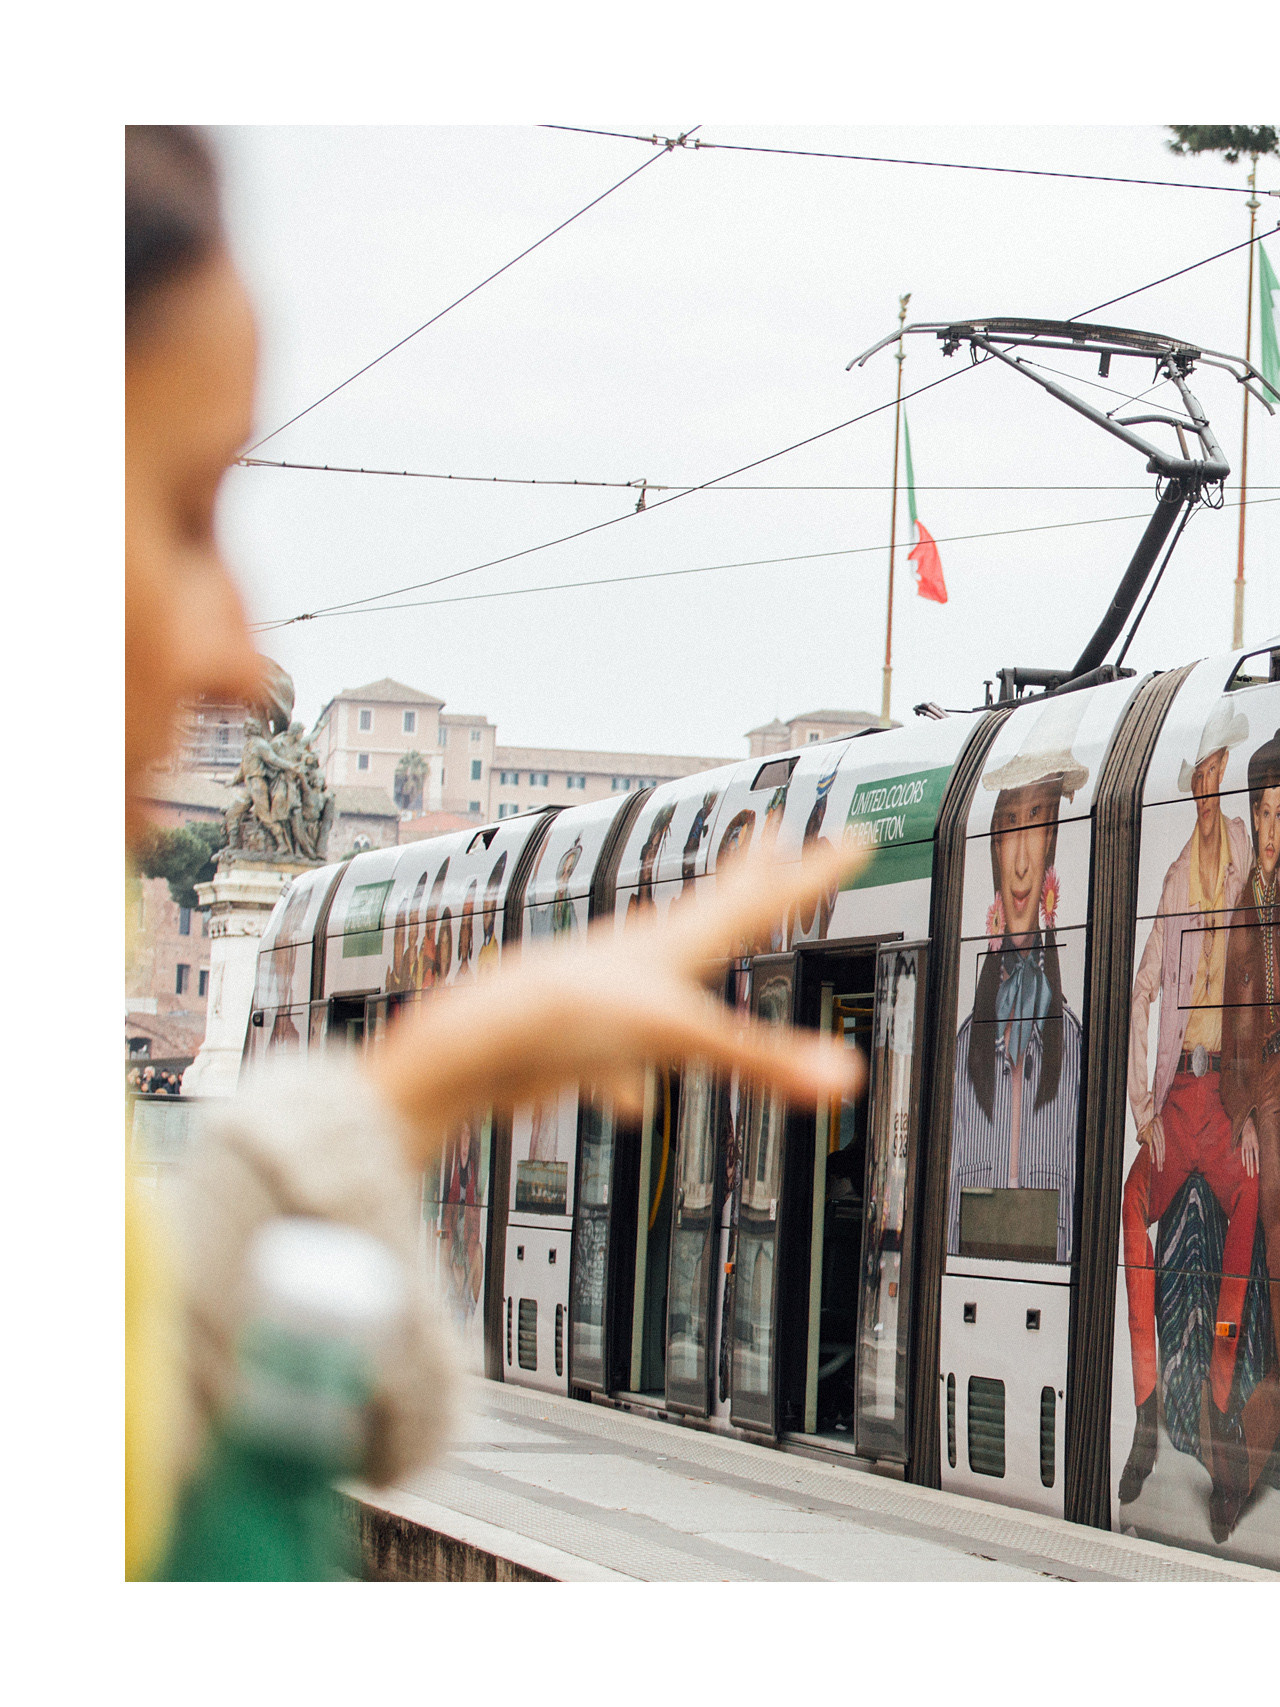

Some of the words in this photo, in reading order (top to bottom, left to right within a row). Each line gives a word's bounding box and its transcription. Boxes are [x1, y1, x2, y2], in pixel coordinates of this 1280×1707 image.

[851, 789, 887, 816] UNITED
[885, 779, 928, 809] COLORS
[857, 814, 906, 846] BENETTON.
